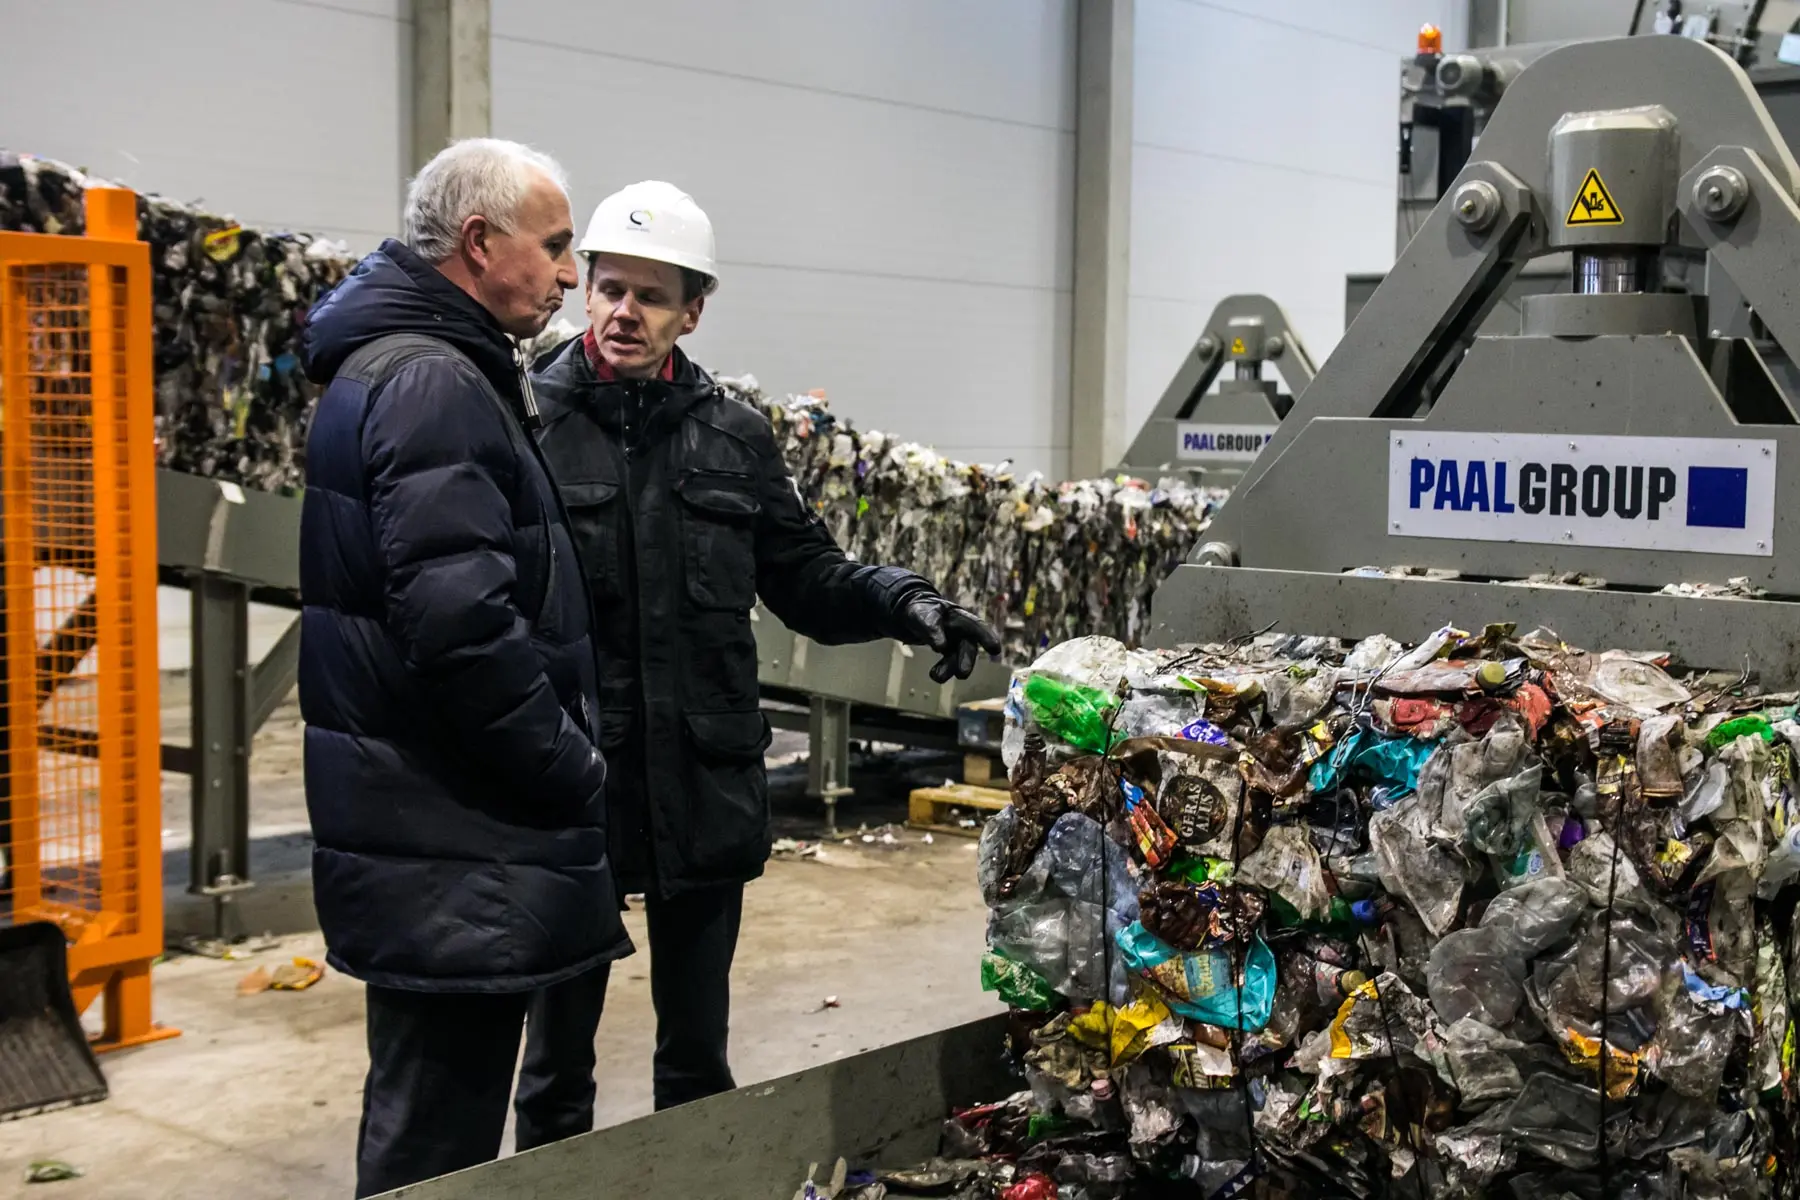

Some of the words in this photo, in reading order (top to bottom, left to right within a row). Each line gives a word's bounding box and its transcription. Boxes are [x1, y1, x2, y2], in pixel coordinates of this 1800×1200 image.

[1184, 433, 1262, 452] PAALGROUP
[1409, 458, 1677, 521] PAALGROUP
[1181, 783, 1201, 838] GERAS
[1196, 794, 1214, 833] ALUS
